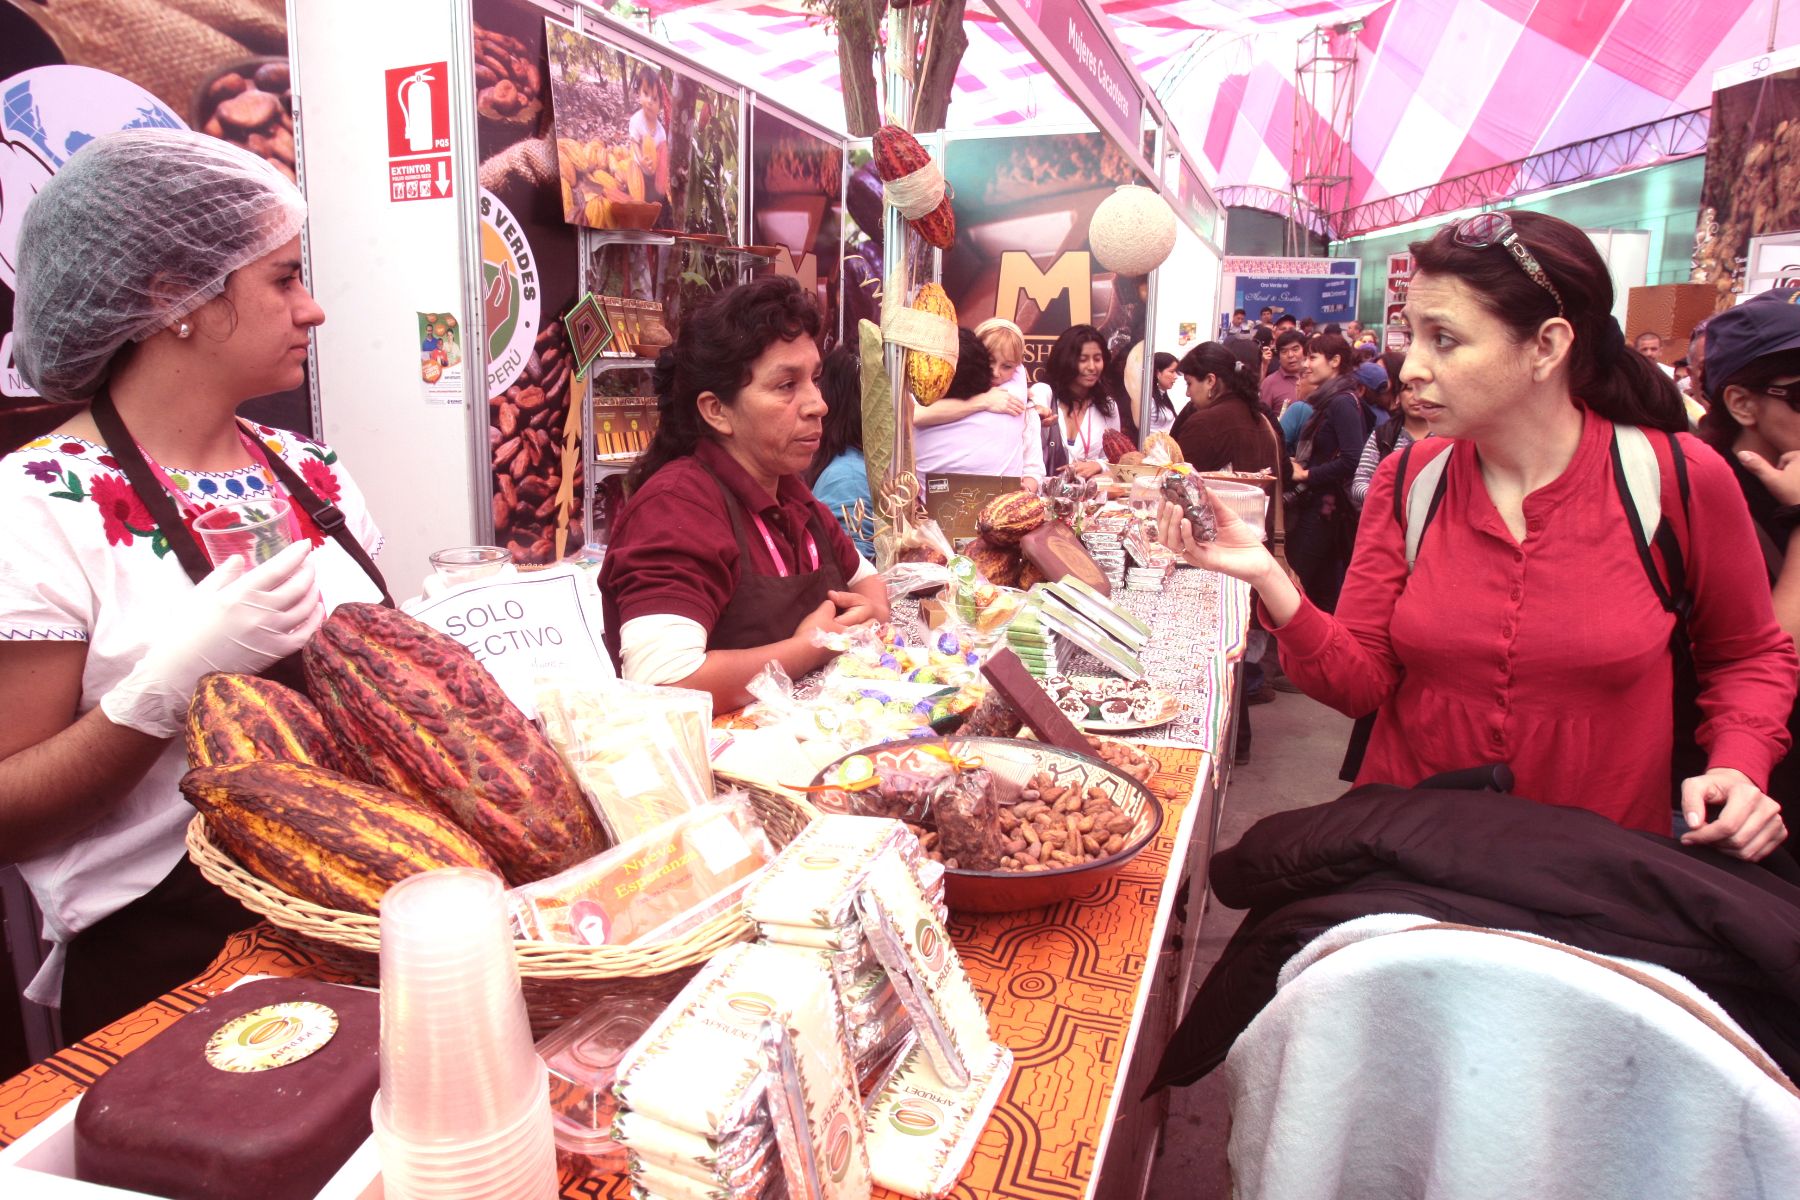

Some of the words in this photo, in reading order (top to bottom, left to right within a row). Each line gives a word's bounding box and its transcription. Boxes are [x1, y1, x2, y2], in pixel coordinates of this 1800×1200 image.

[1068, 17, 1097, 76] Mujeres
[1097, 59, 1129, 119] Cacaoteras
[435, 138, 450, 148] PQS
[391, 163, 431, 176] EXTINTOR
[480, 196, 492, 217] S
[495, 207, 537, 301] VERDES
[446, 600, 524, 637] SOLO
[466, 626, 563, 662] ECTIVO
[622, 842, 677, 876] Nueva
[903, 1085, 956, 1107] APRUDET
